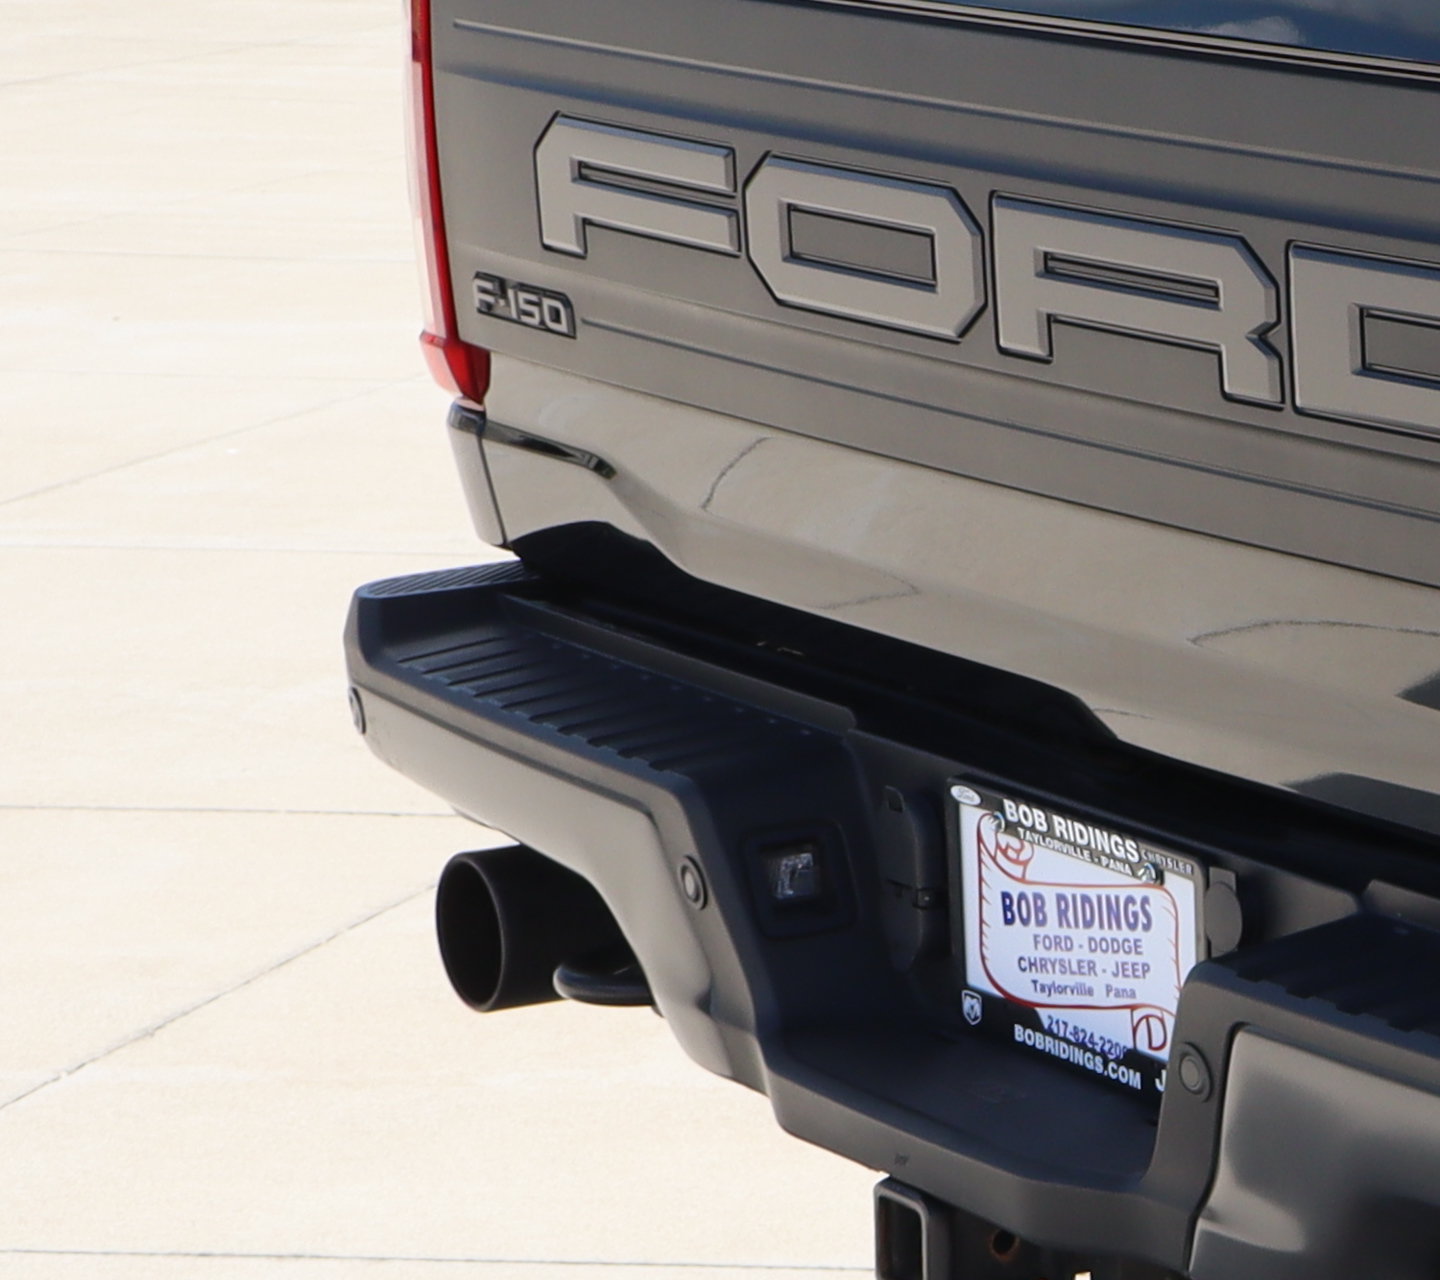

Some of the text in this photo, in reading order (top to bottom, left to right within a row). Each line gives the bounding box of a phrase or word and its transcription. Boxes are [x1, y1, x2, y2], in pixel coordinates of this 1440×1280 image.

[472, 271, 576, 339] F-150
[1003, 799, 1140, 864] BOB RIDINGS
[1017, 828, 1092, 863] TAYLORVILLE
[1101, 854, 1133, 876] PANA
[1001, 890, 1153, 932] BOB RIDINGS
[1033, 934, 1074, 952] FORD
[1088, 936, 1144, 956] DODGE
[1018, 956, 1098, 977] CHRYSLER
[1111, 962, 1151, 980] JEEP
[1031, 979, 1137, 1000] Taylorville Pana
[1014, 1023, 1142, 1091] BOBRIDINGS.COM
